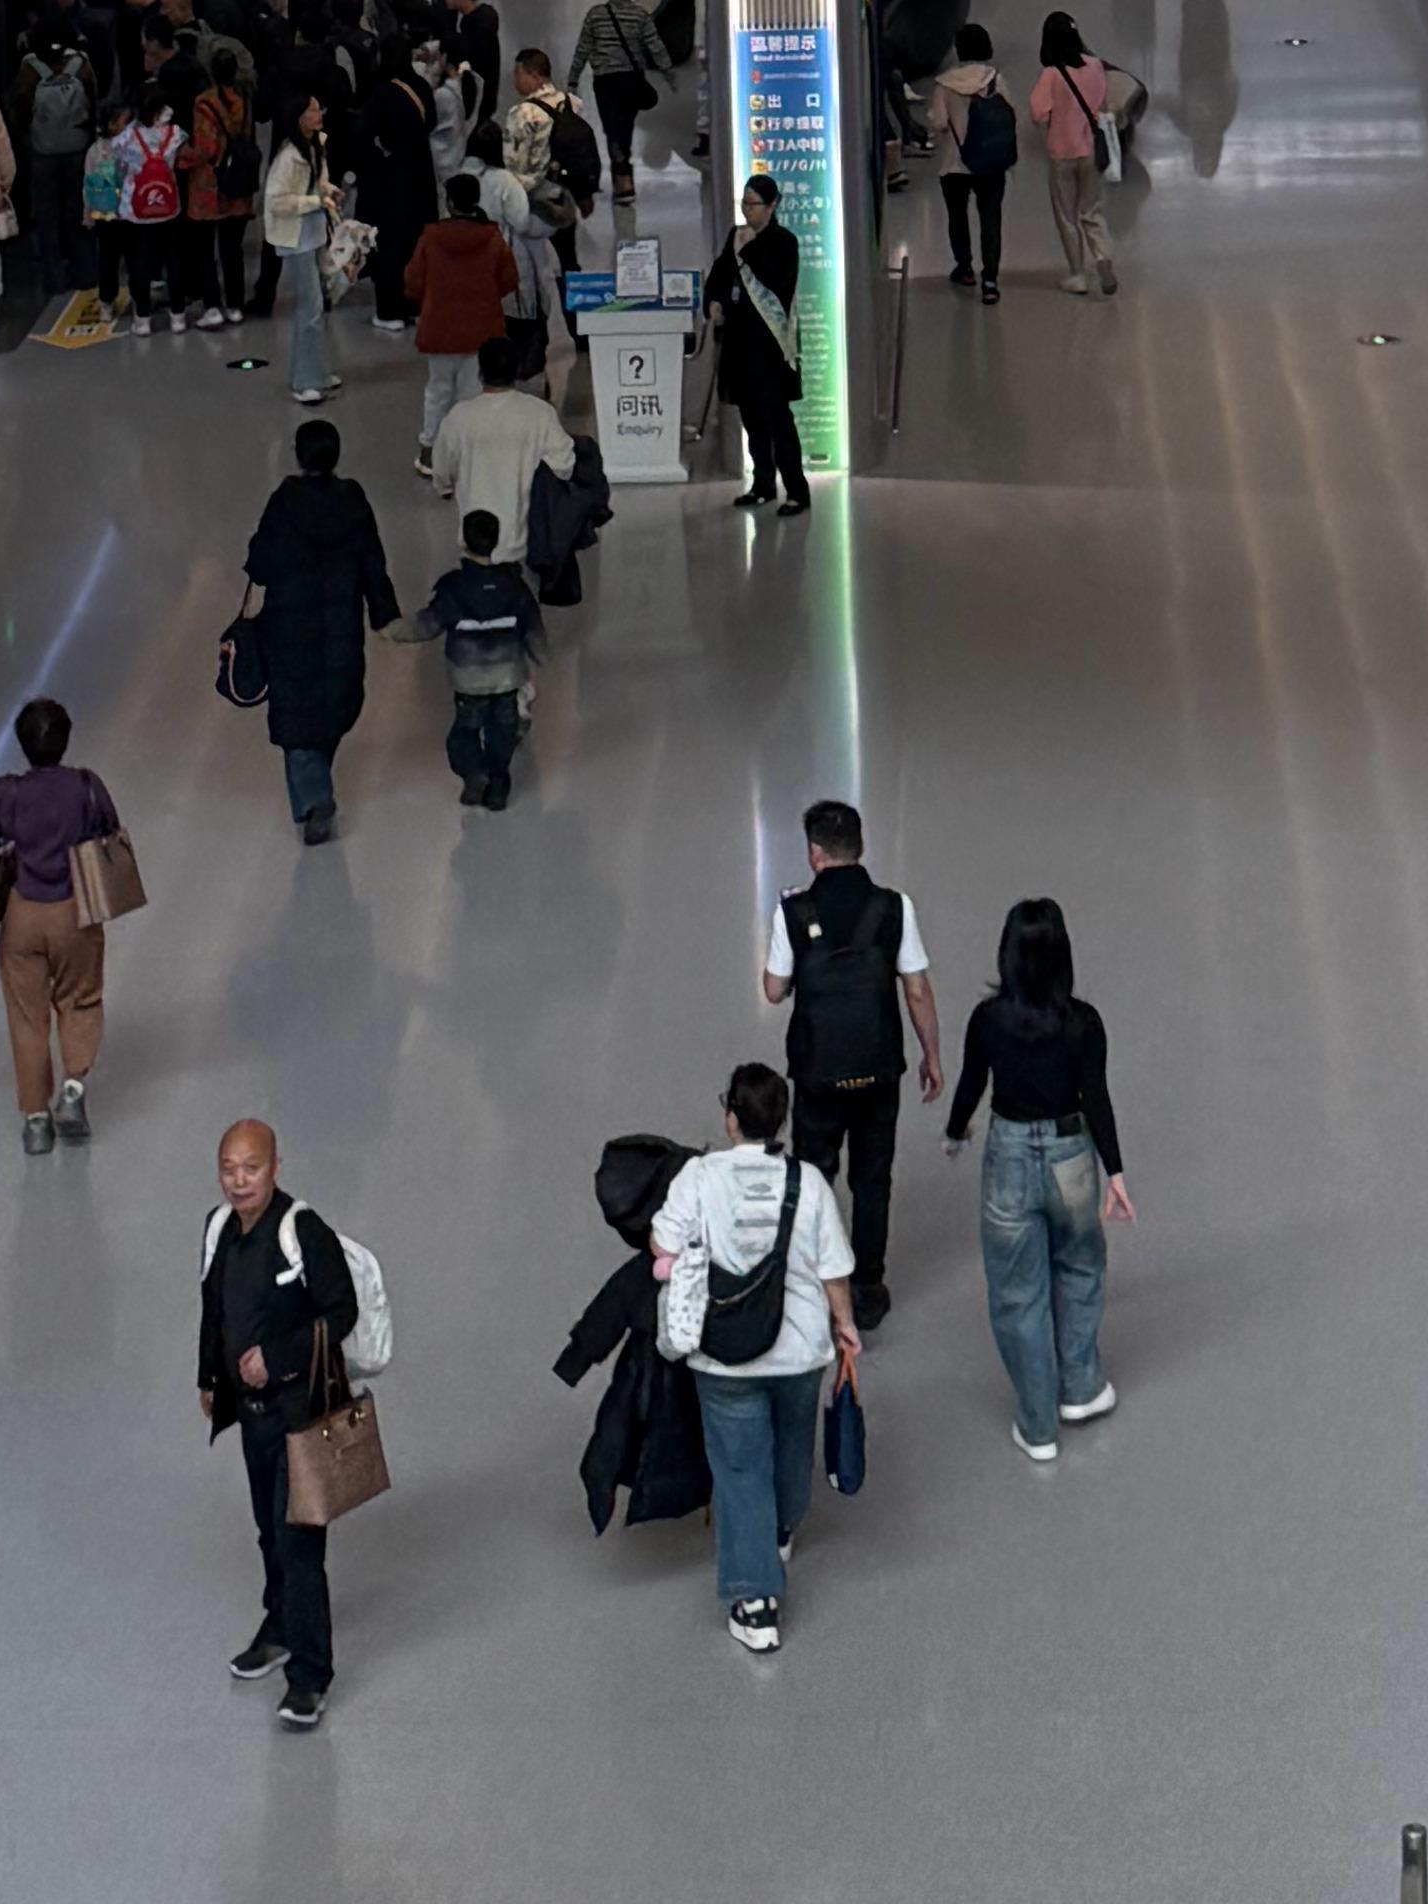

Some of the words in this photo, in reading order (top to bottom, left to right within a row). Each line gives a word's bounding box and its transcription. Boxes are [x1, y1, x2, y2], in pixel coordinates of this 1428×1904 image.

[767, 116, 824, 131] 行李提取
[617, 395, 664, 416] 问讯
